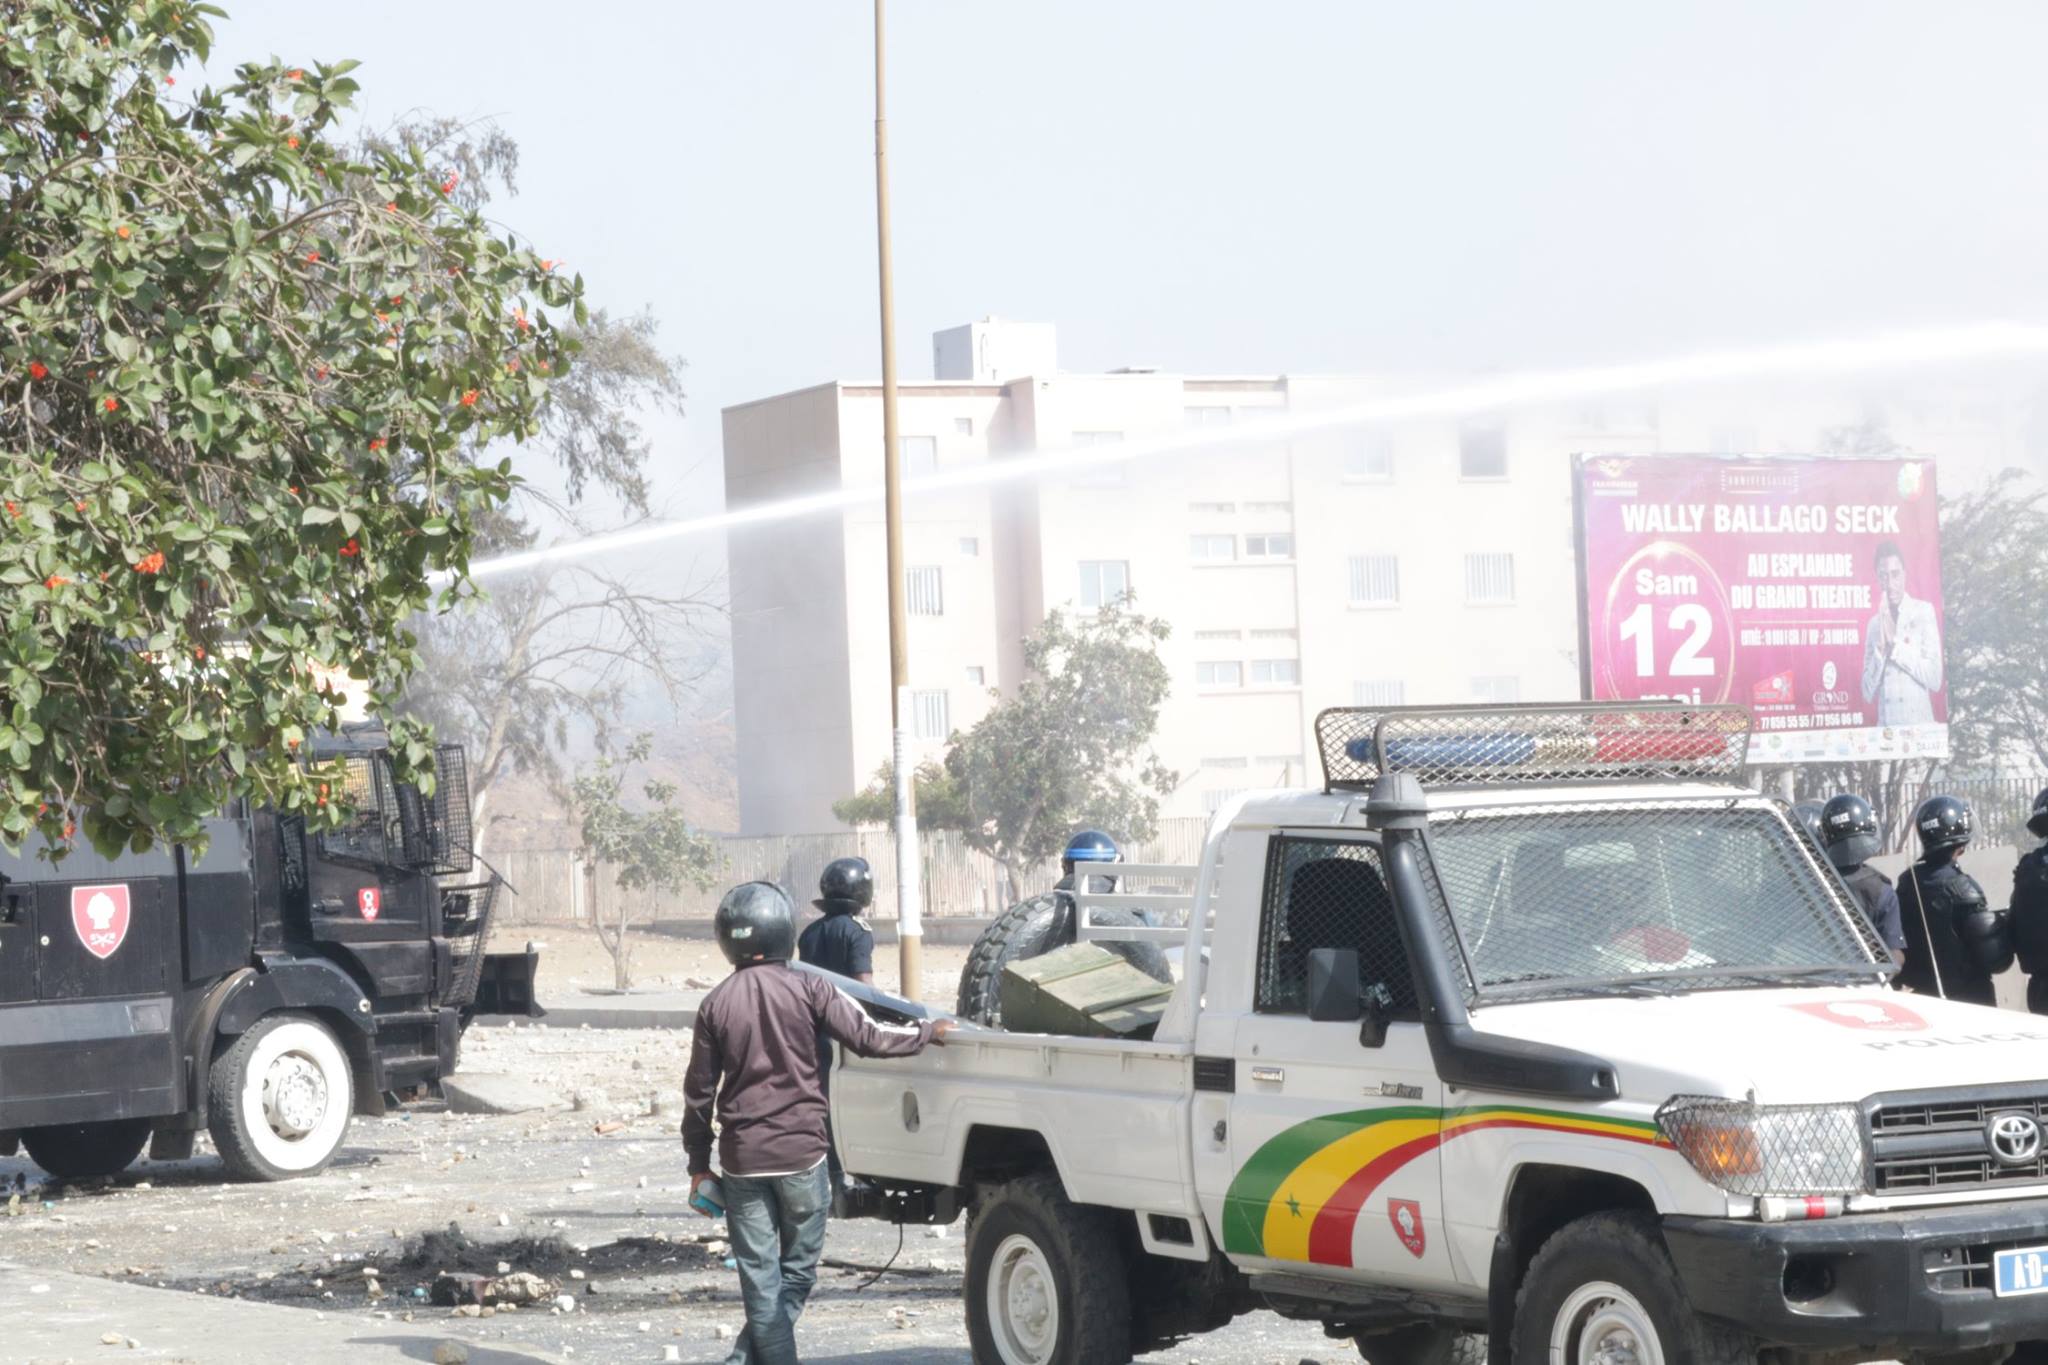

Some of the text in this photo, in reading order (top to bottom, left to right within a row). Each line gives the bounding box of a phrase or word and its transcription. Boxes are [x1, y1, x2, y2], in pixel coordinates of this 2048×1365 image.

[1621, 504, 1900, 534] WALLY BALLAGO SECK
[1747, 553, 1853, 577] AU ESPLANADE
[1635, 568, 1698, 595] Sam
[1731, 585, 1872, 609] DU GRAND THEATRE
[1619, 603, 1716, 677] 12
[1861, 1032, 2048, 1051] POLICE
